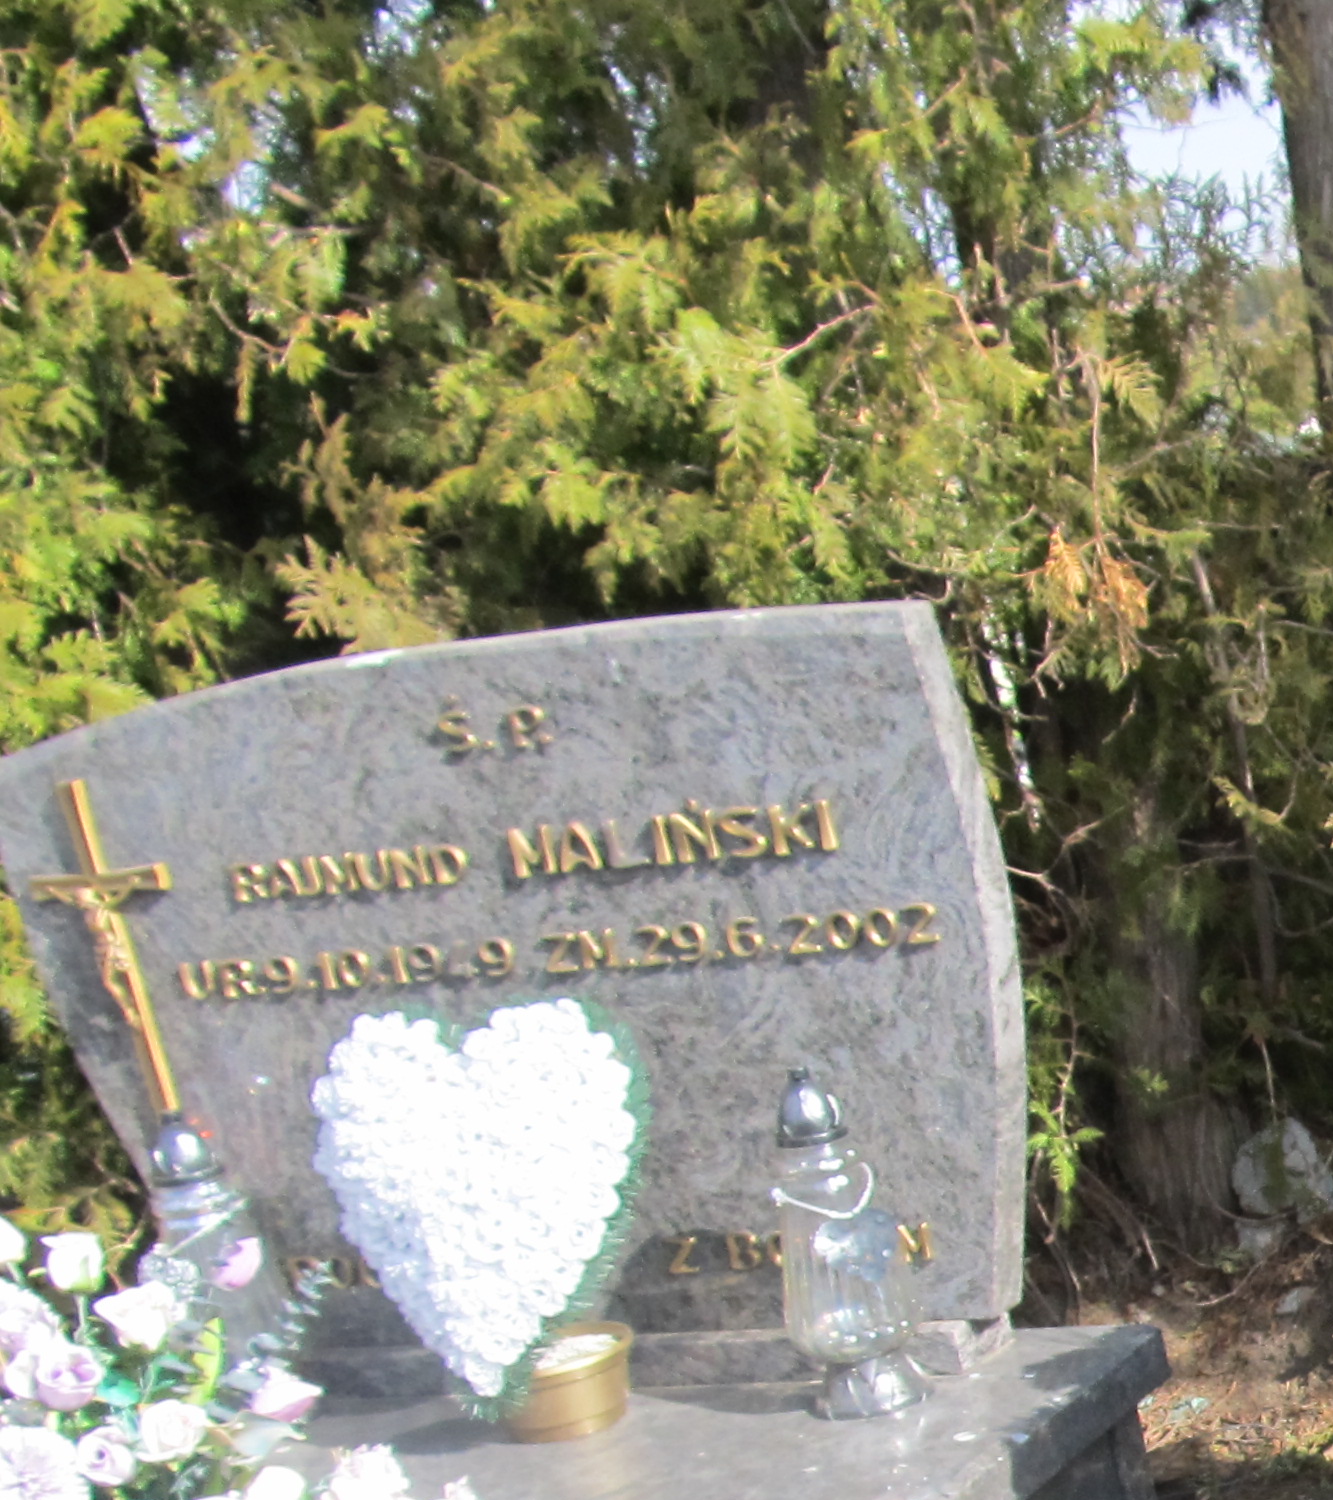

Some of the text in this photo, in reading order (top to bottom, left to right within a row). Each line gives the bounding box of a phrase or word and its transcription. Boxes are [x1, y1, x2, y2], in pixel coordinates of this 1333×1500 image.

[230, 799, 841, 903] RAJMUND MALIŃSKI
[664, 1233, 701, 1275] Z
